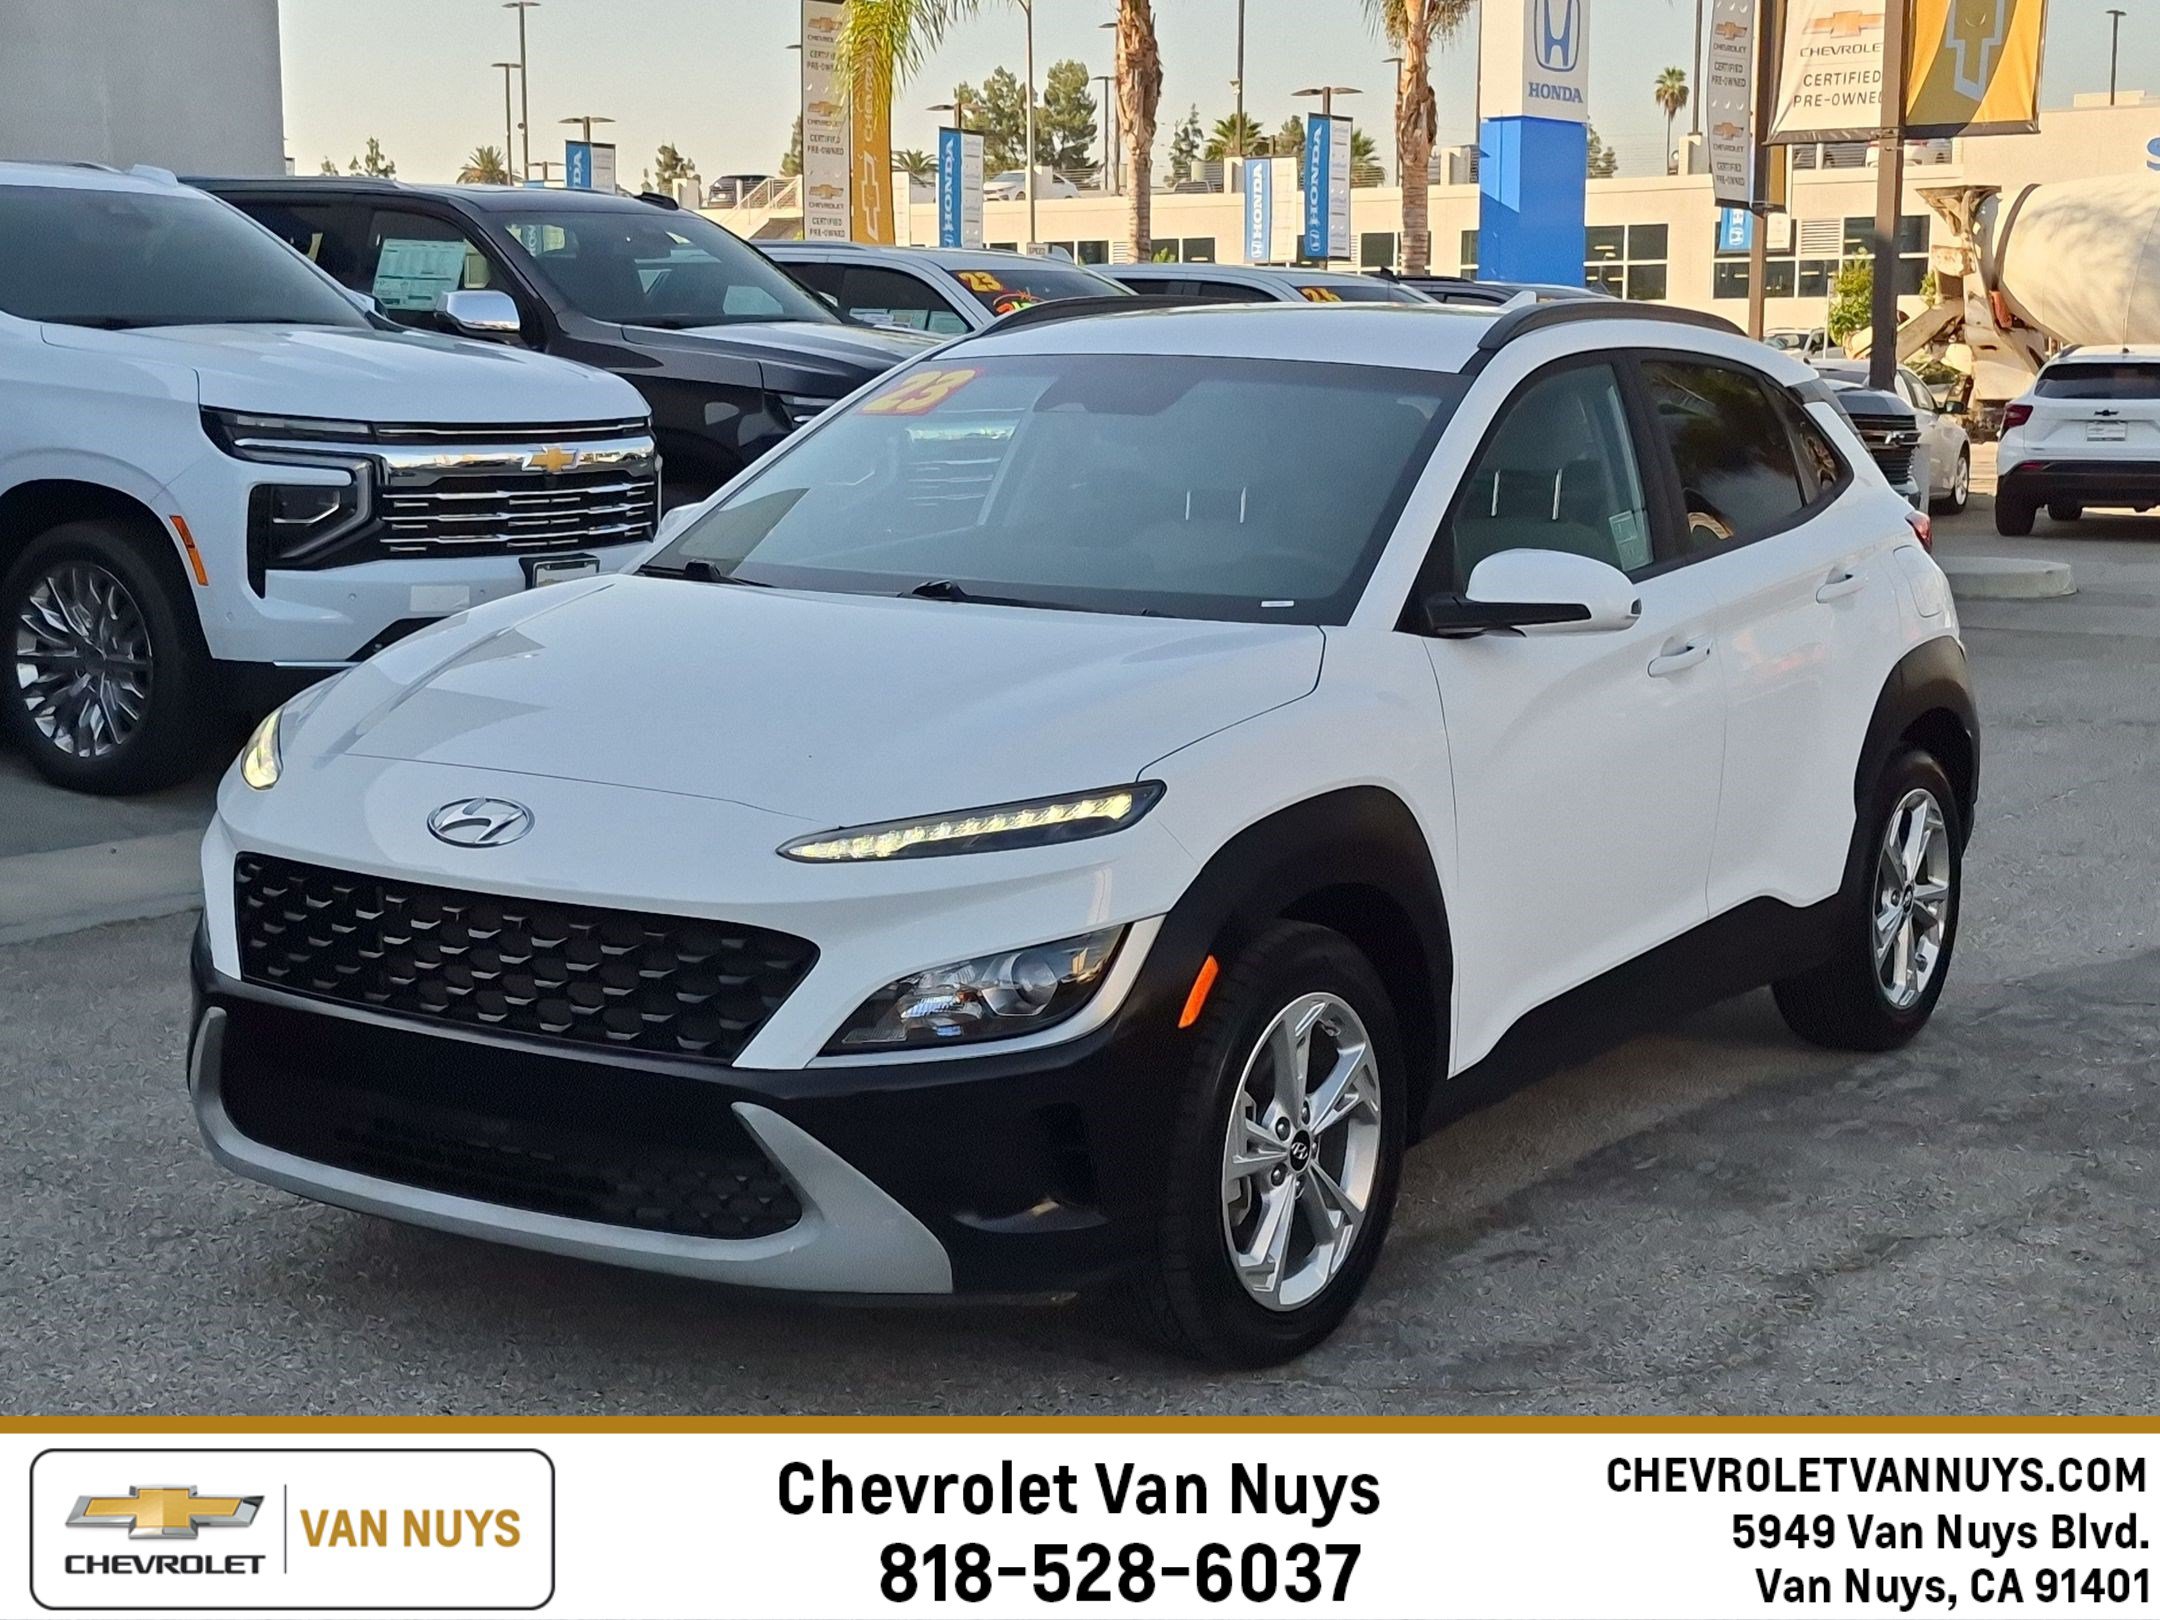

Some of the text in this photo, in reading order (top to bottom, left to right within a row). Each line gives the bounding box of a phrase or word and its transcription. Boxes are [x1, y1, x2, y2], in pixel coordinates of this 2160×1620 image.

[1800, 42, 1884, 58] CHEVROLE
[1528, 82, 1583, 103] HONDA
[1803, 70, 1882, 87] CERTIFIED
[943, 137, 955, 232] HONDA
[1309, 124, 1323, 227] HONDA
[1252, 162, 1263, 241] HONDA
[958, 271, 1004, 292] 23
[861, 369, 977, 412] 23
